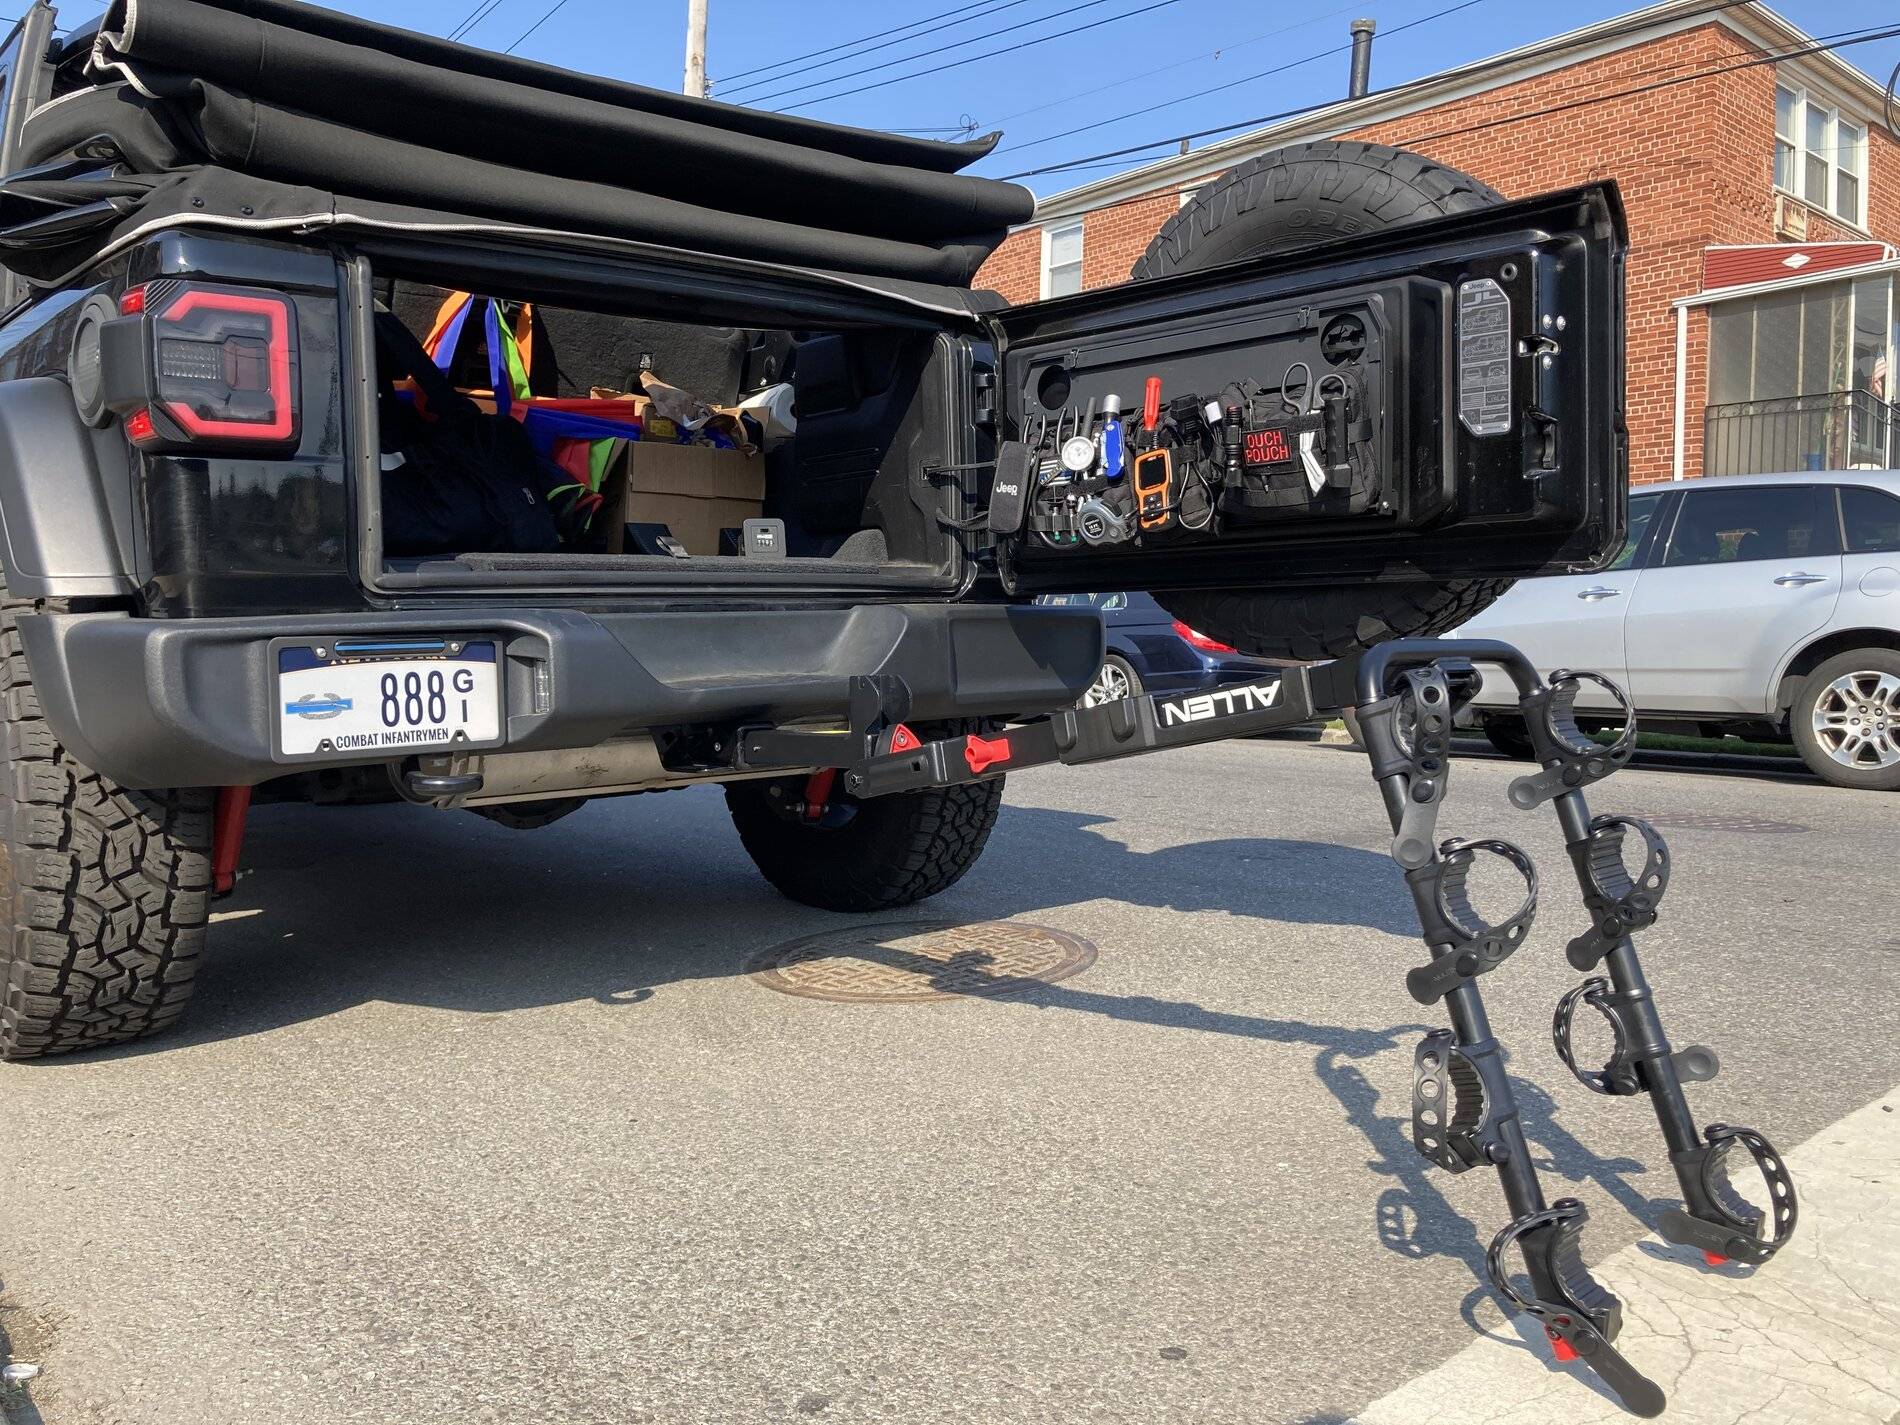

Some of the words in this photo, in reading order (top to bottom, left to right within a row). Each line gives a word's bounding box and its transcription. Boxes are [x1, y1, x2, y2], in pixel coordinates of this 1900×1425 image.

[1247, 431, 1283, 448] OUCH
[1245, 445, 1289, 463] POUCH
[996, 481, 1018, 496] Jeep
[380, 670, 447, 728] 888
[452, 668, 474, 693] G
[1161, 680, 1282, 727] ALLEN
[336, 732, 379, 749] COMBAT
[381, 727, 450, 745] INFANTRYMEN
